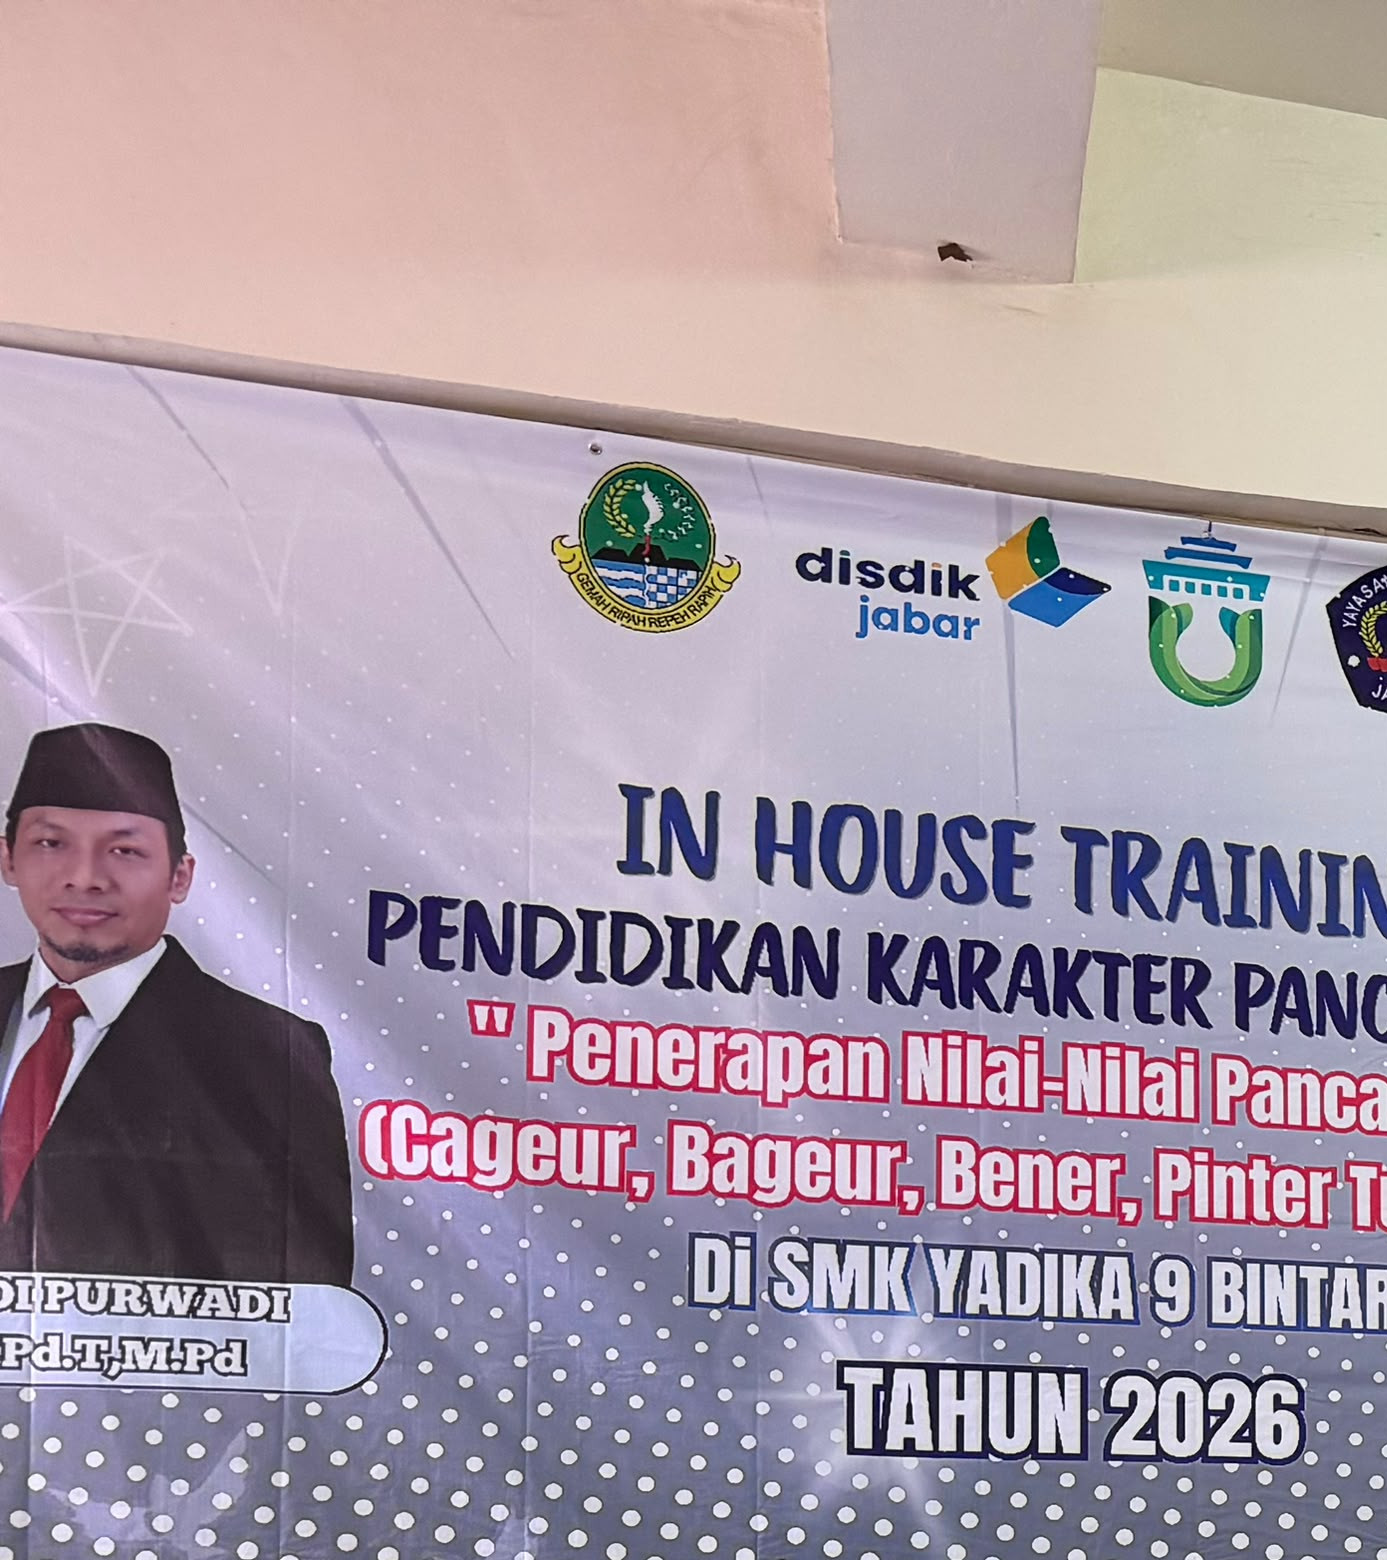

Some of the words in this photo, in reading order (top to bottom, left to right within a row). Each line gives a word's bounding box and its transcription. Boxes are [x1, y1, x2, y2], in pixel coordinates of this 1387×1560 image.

[795, 547, 981, 602] disdik
[855, 594, 980, 640] jabar
[617, 783, 721, 882] IN
[754, 796, 1037, 908] HOUSE
[366, 889, 841, 1001] PENDIDIKAN
[866, 931, 1213, 1031] KARAKTER
[526, 1005, 891, 1108] Penerapan
[902, 1029, 1200, 1125] Nilai-Nilai
[358, 1099, 655, 1202] (Cageur,
[666, 1119, 925, 1215] Bageur,
[935, 1134, 1143, 1227] Bener,
[1154, 1147, 1337, 1229] Pinter
[41, 1277, 291, 1324] PURWADI
[689, 1231, 756, 1310] Di
[768, 1236, 917, 1317] SMK
[920, 1242, 1141, 1325] YADIKA
[1149, 1254, 1199, 1327] 9
[837, 1359, 1090, 1461] TAHUN
[1102, 1370, 1308, 1464] 2026
